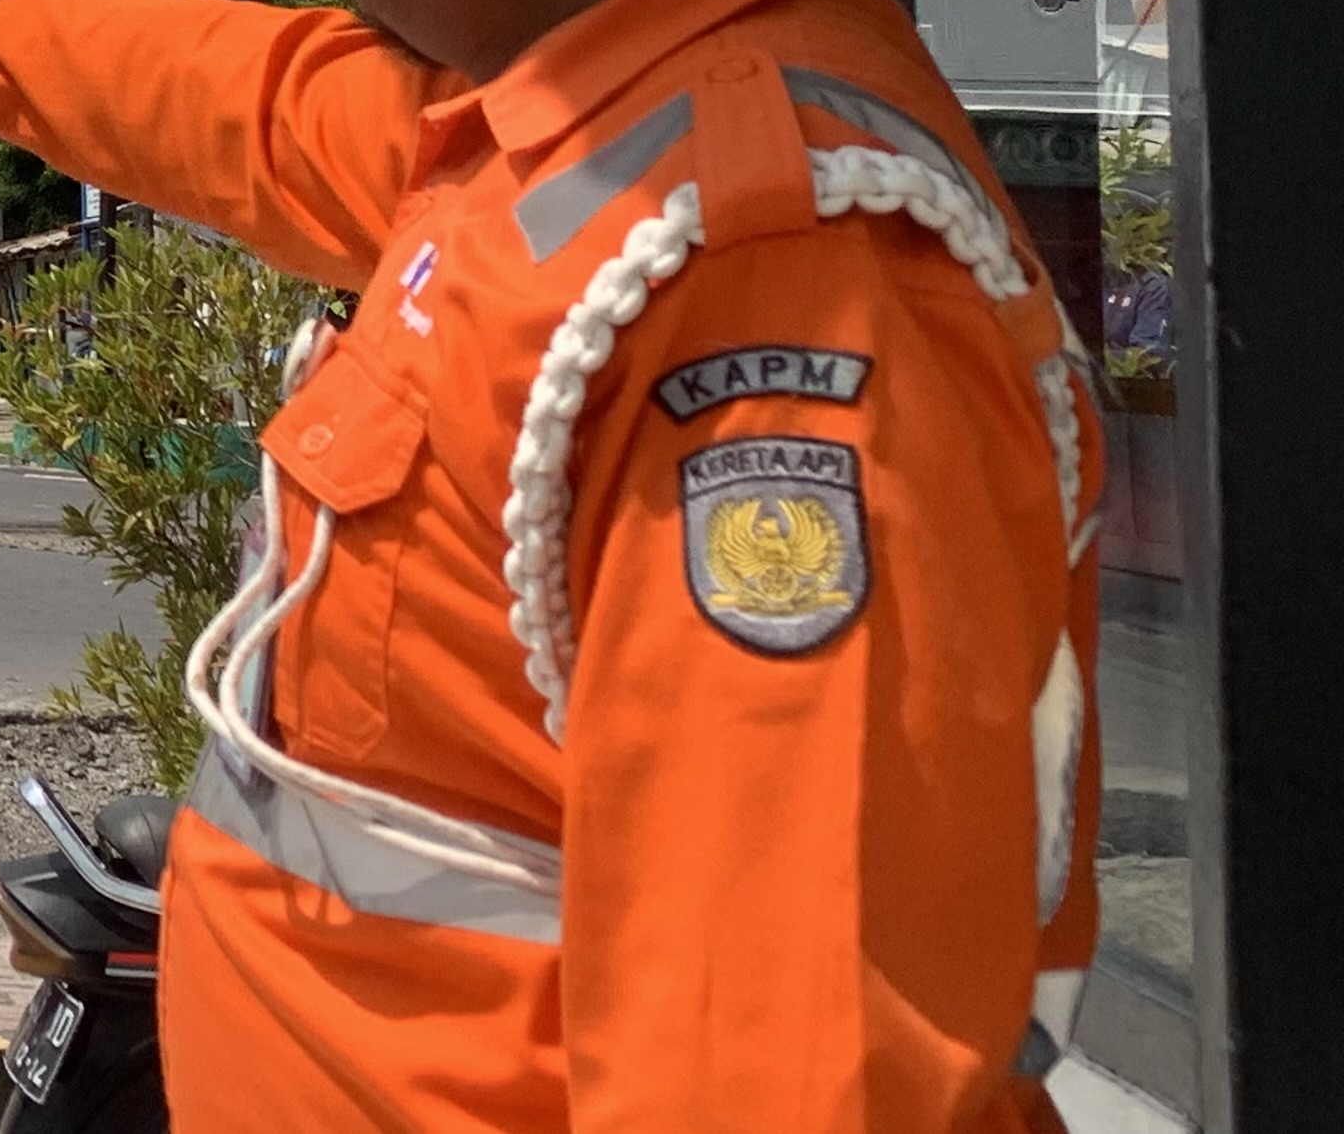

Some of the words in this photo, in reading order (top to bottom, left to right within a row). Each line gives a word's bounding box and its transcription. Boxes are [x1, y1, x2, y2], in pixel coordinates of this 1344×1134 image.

[678, 355, 837, 405] KAPM
[687, 445, 791, 482] KERETA
[796, 447, 844, 479] API
